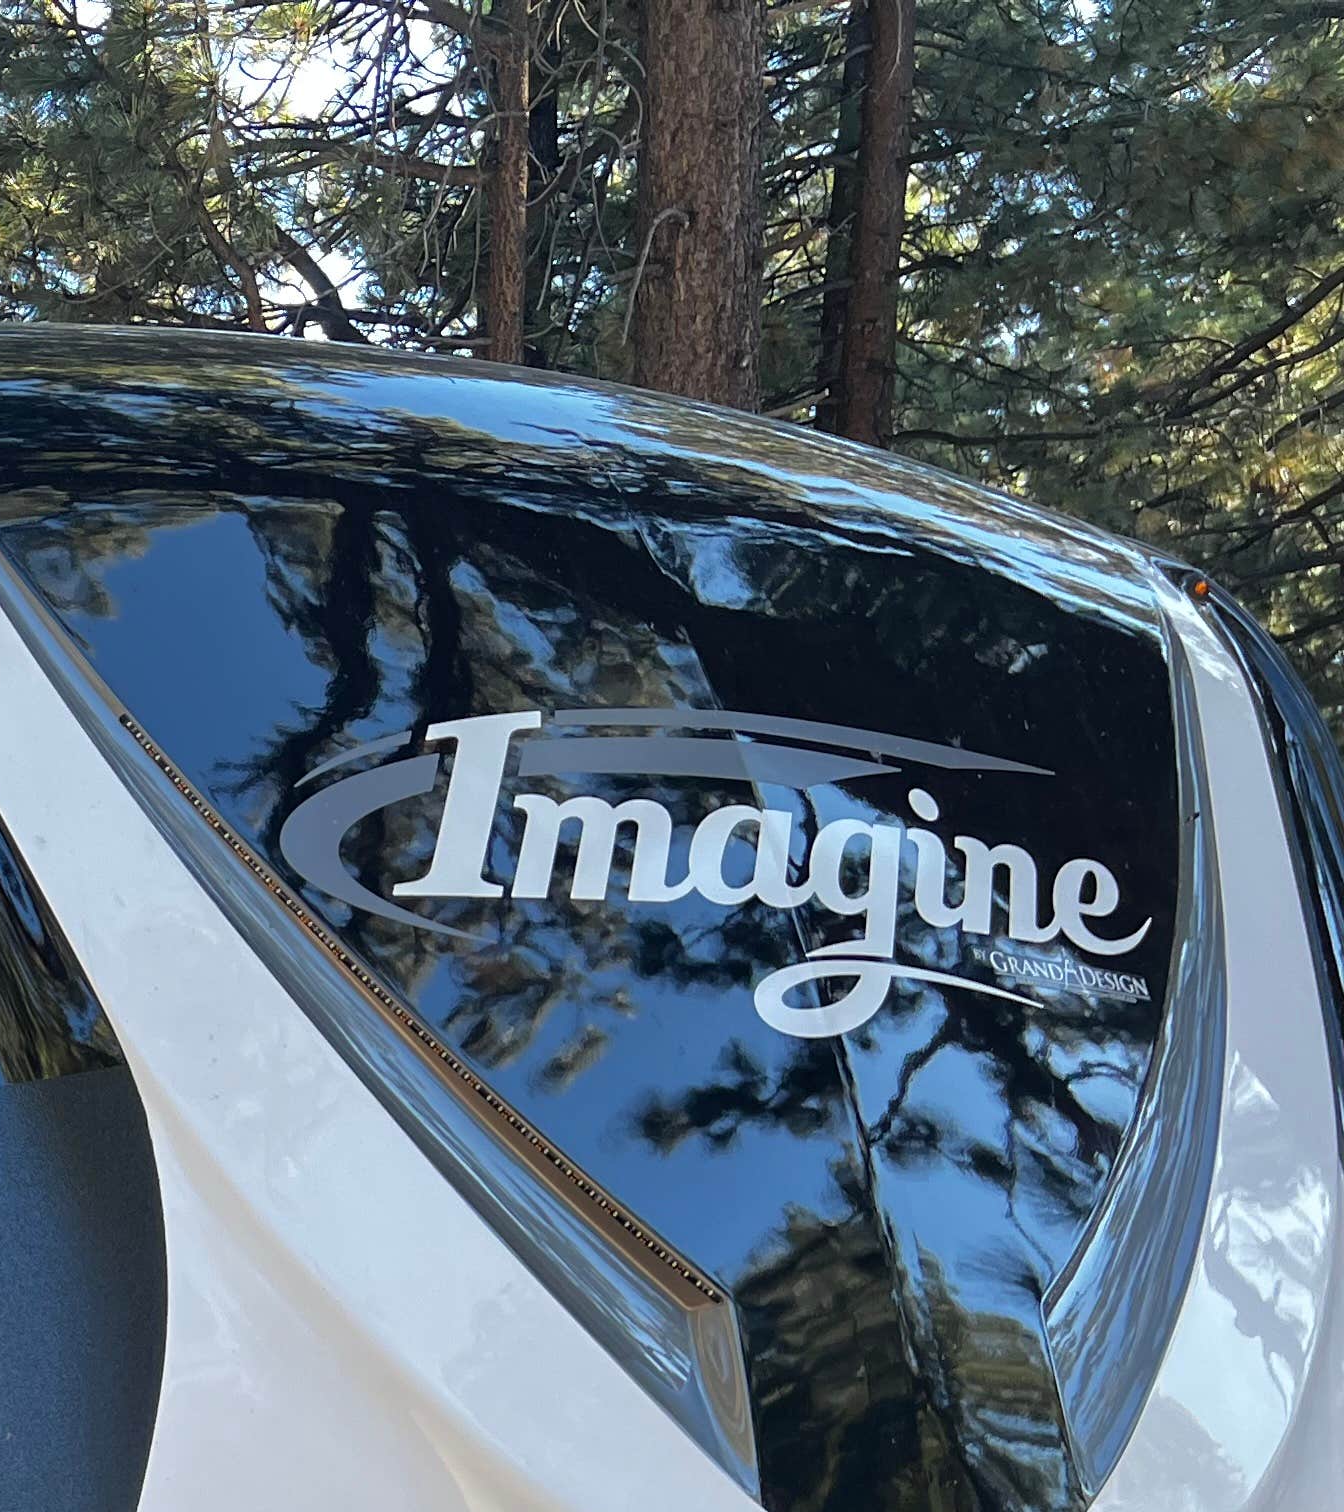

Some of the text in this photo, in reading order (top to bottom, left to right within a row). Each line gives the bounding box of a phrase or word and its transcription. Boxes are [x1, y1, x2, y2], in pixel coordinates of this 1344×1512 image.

[393, 710, 1152, 1038] Imagine
[990, 951, 1063, 982] GRAND
[1078, 964, 1149, 997] DESIGN
